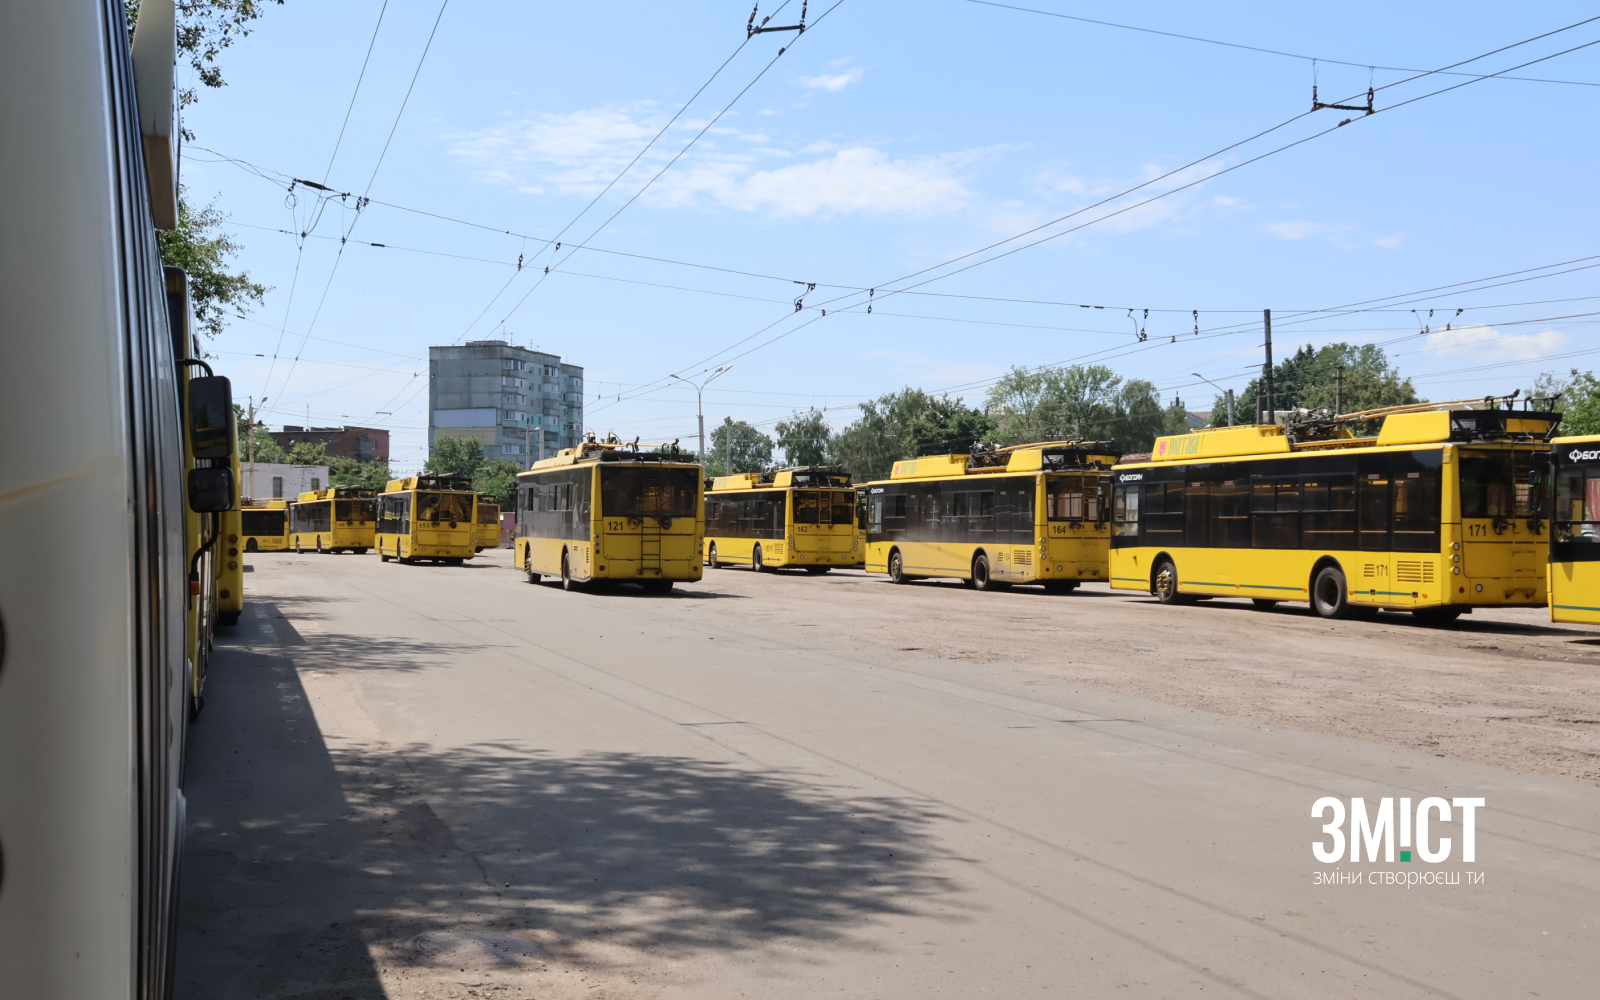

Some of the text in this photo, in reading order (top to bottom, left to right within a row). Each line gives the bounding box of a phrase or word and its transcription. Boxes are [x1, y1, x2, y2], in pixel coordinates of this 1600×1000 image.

[607, 521, 623, 531] 121
[1052, 525, 1067, 534] 164
[1468, 524, 1486, 537] 171
[1376, 564, 1388, 577] 171
